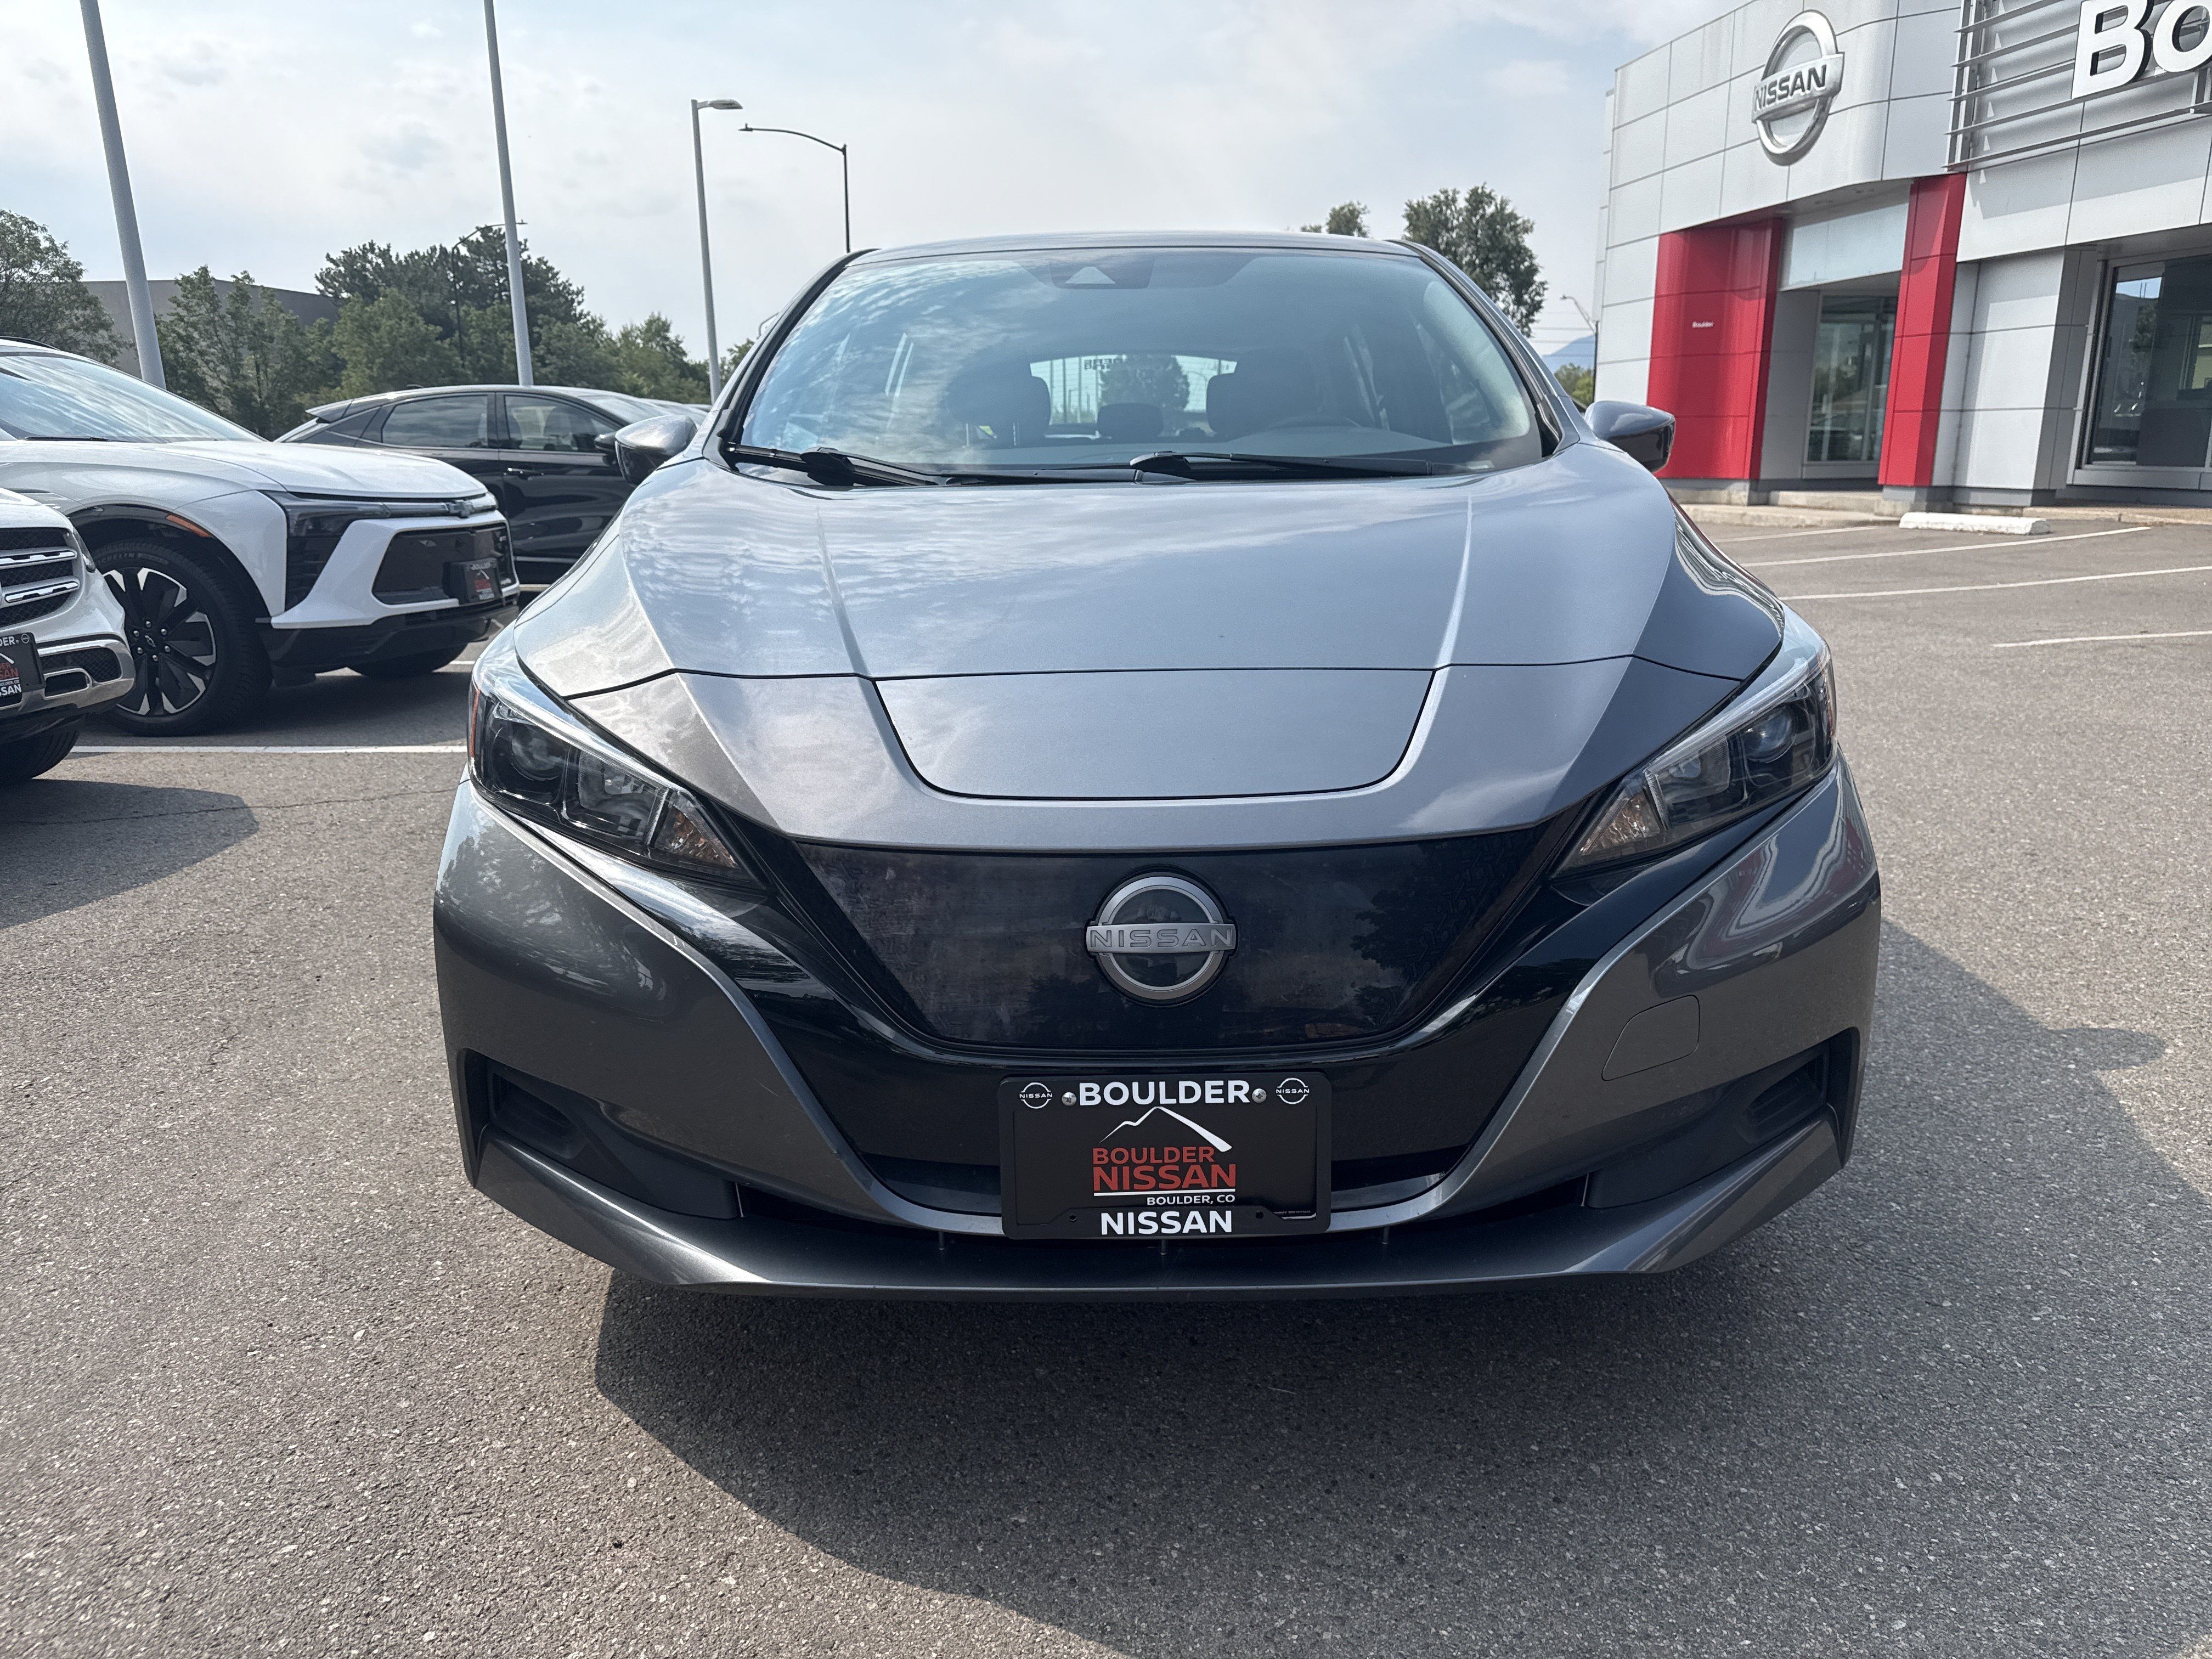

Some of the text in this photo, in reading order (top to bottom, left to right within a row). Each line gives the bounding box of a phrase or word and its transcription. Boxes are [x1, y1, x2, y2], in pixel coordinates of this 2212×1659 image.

[1754, 64, 1827, 111] NISSAN
[1090, 928, 1232, 948] NISSAN
[1079, 1080, 1250, 1106] BOULDER
[1092, 1146, 1215, 1165] BOULDER
[1093, 1164, 1236, 1191] NISSAN
[1147, 1194, 1235, 1206] BOULDER, CO
[1101, 1210, 1232, 1235] NISSAN
